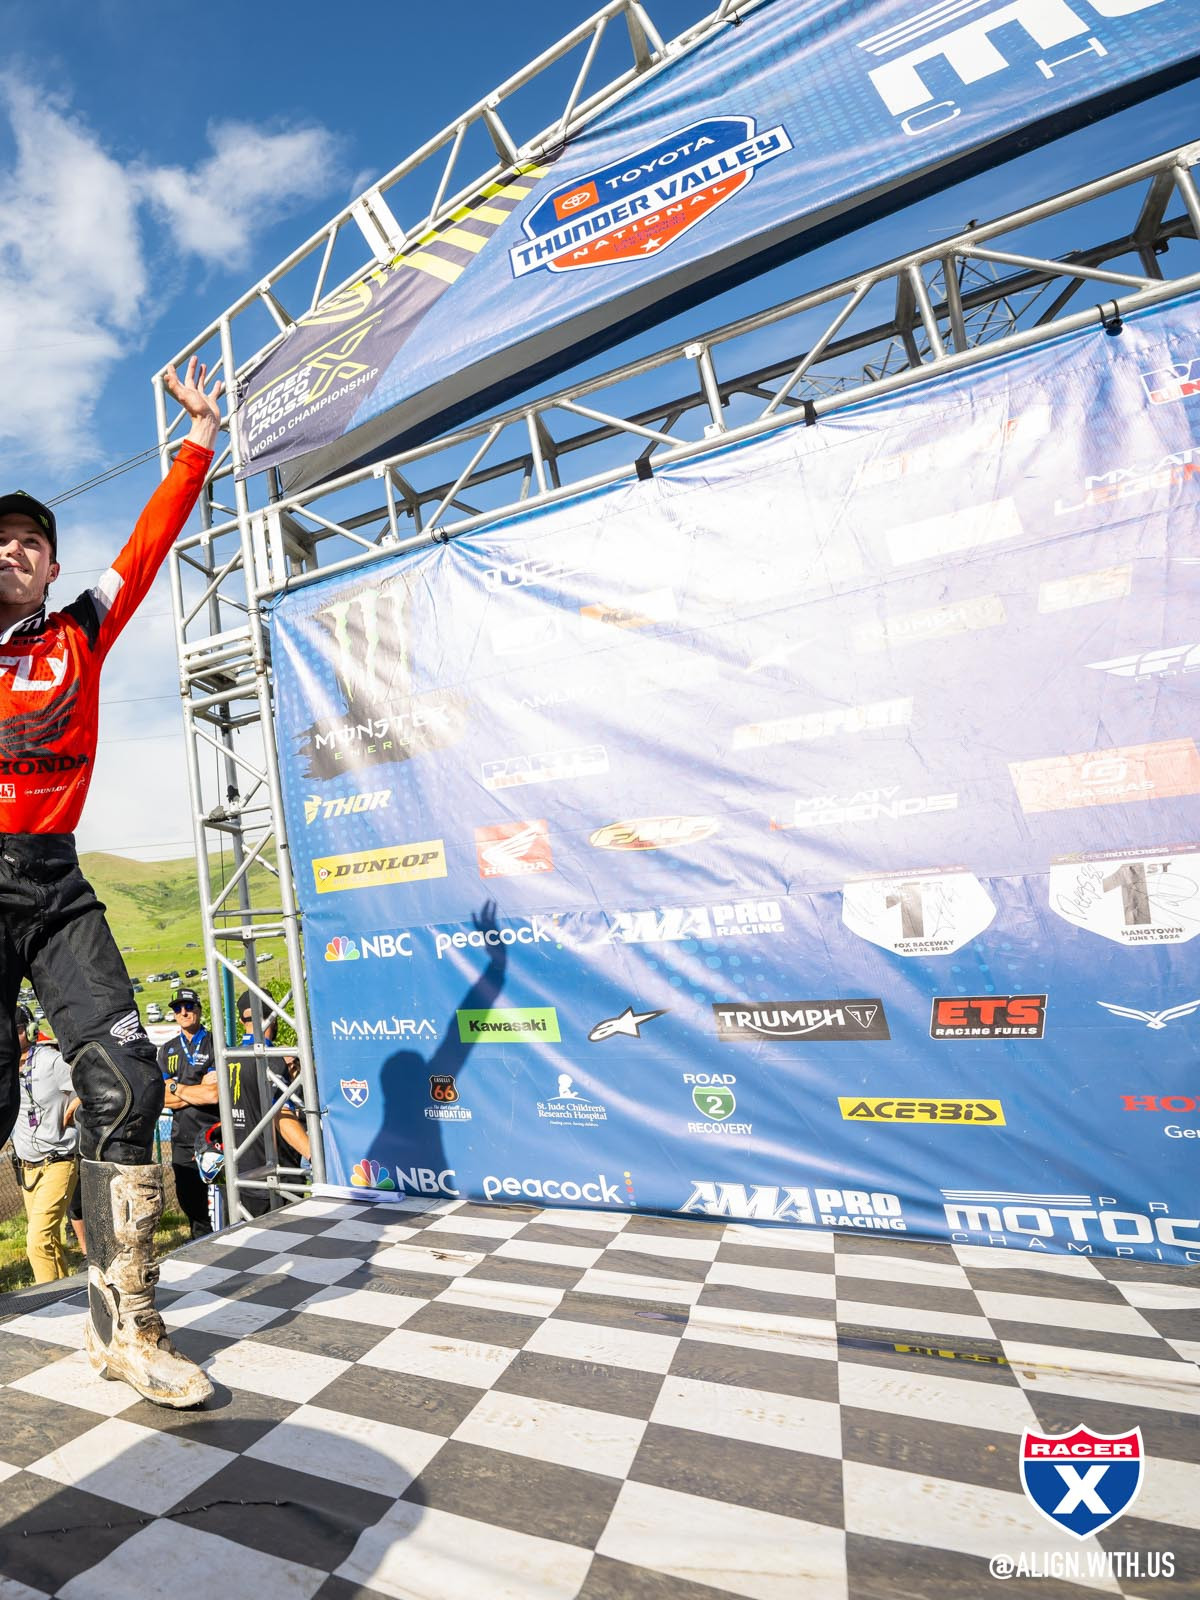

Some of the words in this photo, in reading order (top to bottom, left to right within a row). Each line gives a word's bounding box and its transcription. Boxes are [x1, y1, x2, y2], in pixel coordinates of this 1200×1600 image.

[605, 135, 716, 189] TOYOTA
[517, 193, 651, 266] THUNDER
[654, 134, 781, 201] VALLEY
[572, 185, 726, 260] NATIONAL
[246, 366, 313, 419] SUPER
[250, 378, 309, 428] MOTO
[248, 389, 311, 442] CROSS
[251, 425, 286, 457] WORLD
[288, 367, 379, 430] CHAMPIONSHIP
[321, 789, 393, 820] THOR
[334, 851, 440, 878] DUNLOP
[713, 901, 782, 926] PRO
[360, 932, 413, 960] NBC
[435, 920, 552, 959] peacock
[717, 923, 785, 937] RACING
[1120, 927, 1184, 937] HANGTOWN
[912, 939, 955, 948] RACEWAY
[718, 1006, 846, 1035] TRIUMPH
[936, 998, 1045, 1027] ETS
[330, 1015, 438, 1036] NAMURA
[468, 1016, 548, 1034] Kawasaki
[935, 1026, 990, 1036] RACING
[993, 1025, 1038, 1036] FUELS
[683, 1073, 737, 1086] ROAD
[349, 1088, 364, 1102] X
[434, 1085, 455, 1100] 66
[424, 1109, 472, 1119] FOUNDATION
[536, 1101, 546, 1110] St.
[547, 1102, 566, 1111] Jude
[566, 1103, 606, 1113] Children's
[706, 1095, 725, 1115] 2
[1119, 1095, 1200, 1112] HO
[538, 1109, 573, 1119] Research
[573, 1111, 608, 1122] Hospital
[687, 1121, 753, 1135] RECOVERY
[395, 1164, 460, 1195] NBC
[482, 1174, 625, 1204] peacock
[678, 1180, 817, 1225] AMA
[814, 1188, 902, 1217] PRO
[820, 1214, 907, 1231] RACING
